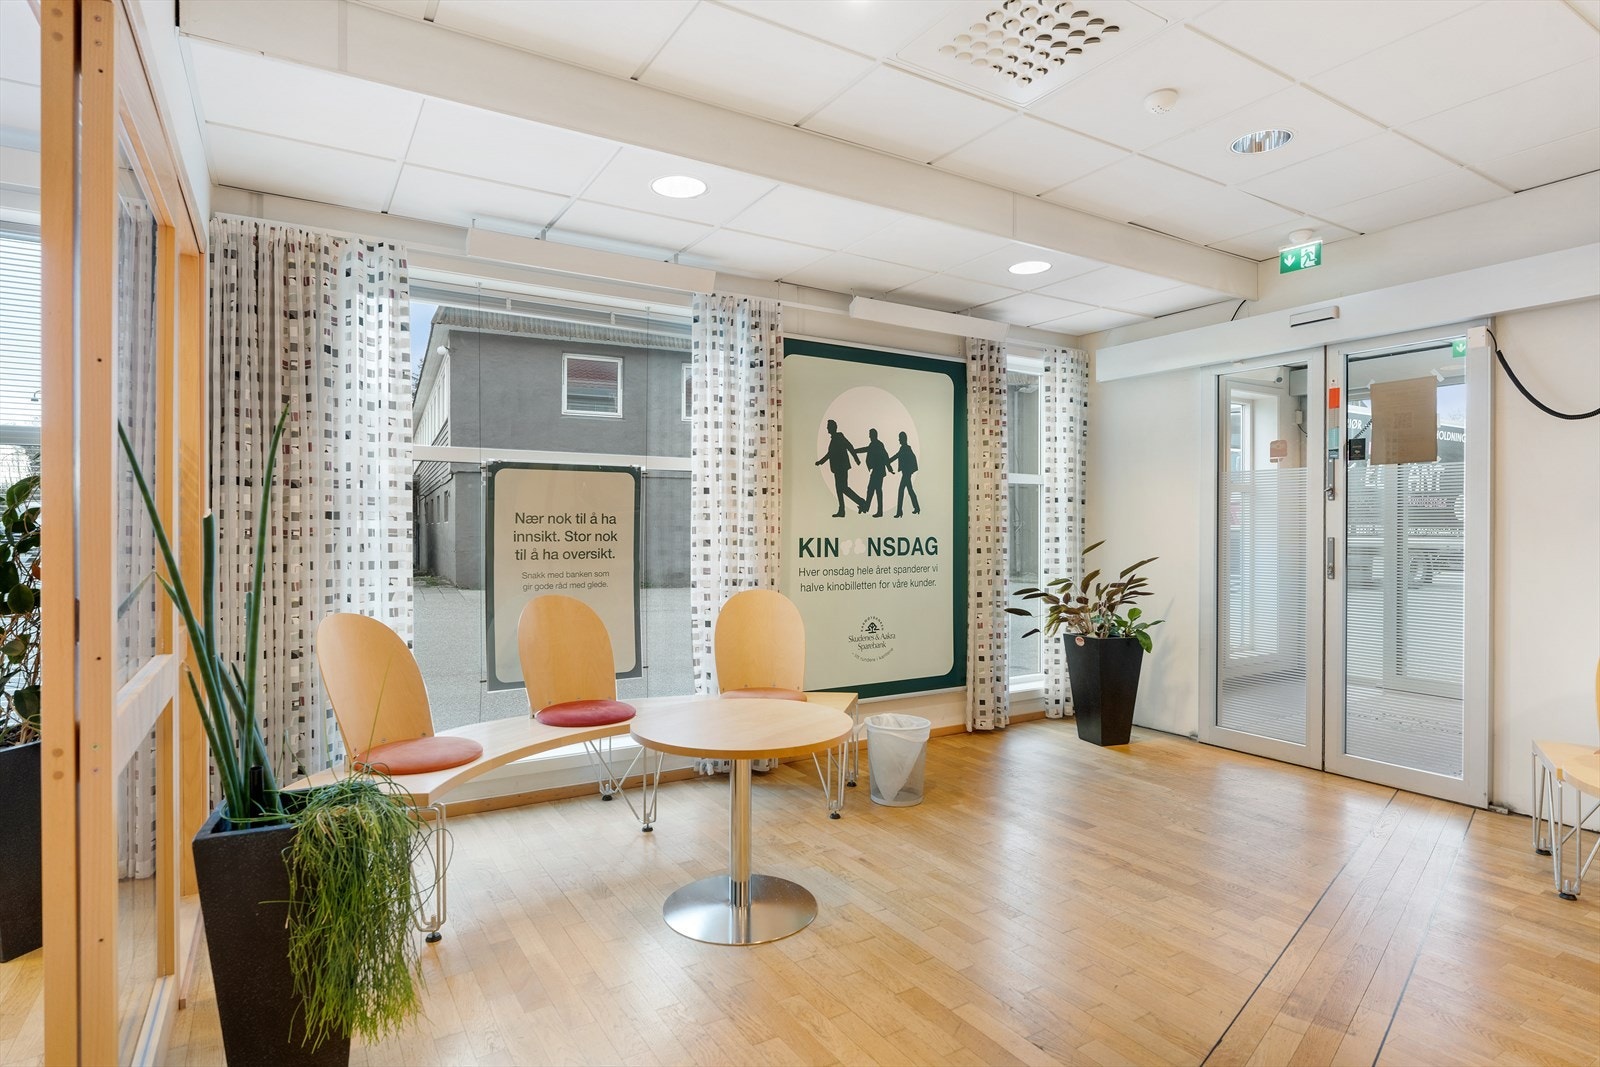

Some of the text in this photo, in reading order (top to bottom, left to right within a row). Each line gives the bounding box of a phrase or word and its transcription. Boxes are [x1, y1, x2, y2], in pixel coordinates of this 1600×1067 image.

[515, 512, 617, 525] Nær nok til å ha
[513, 530, 618, 542] innsikt. Stor nok
[515, 548, 616, 560] til å ha oversikt.
[521, 571, 546, 580] Snakk
[547, 571, 564, 579] med
[566, 570, 592, 578] banken
[798, 564, 939, 577] Hver onsdag hele året spanderer vi
[522, 583, 532, 592] gir
[534, 582, 554, 591] gode
[569, 581, 585, 589] med
[587, 581, 609, 590] glede.
[800, 579, 937, 592] halve kinobilletten for våre kunder.
